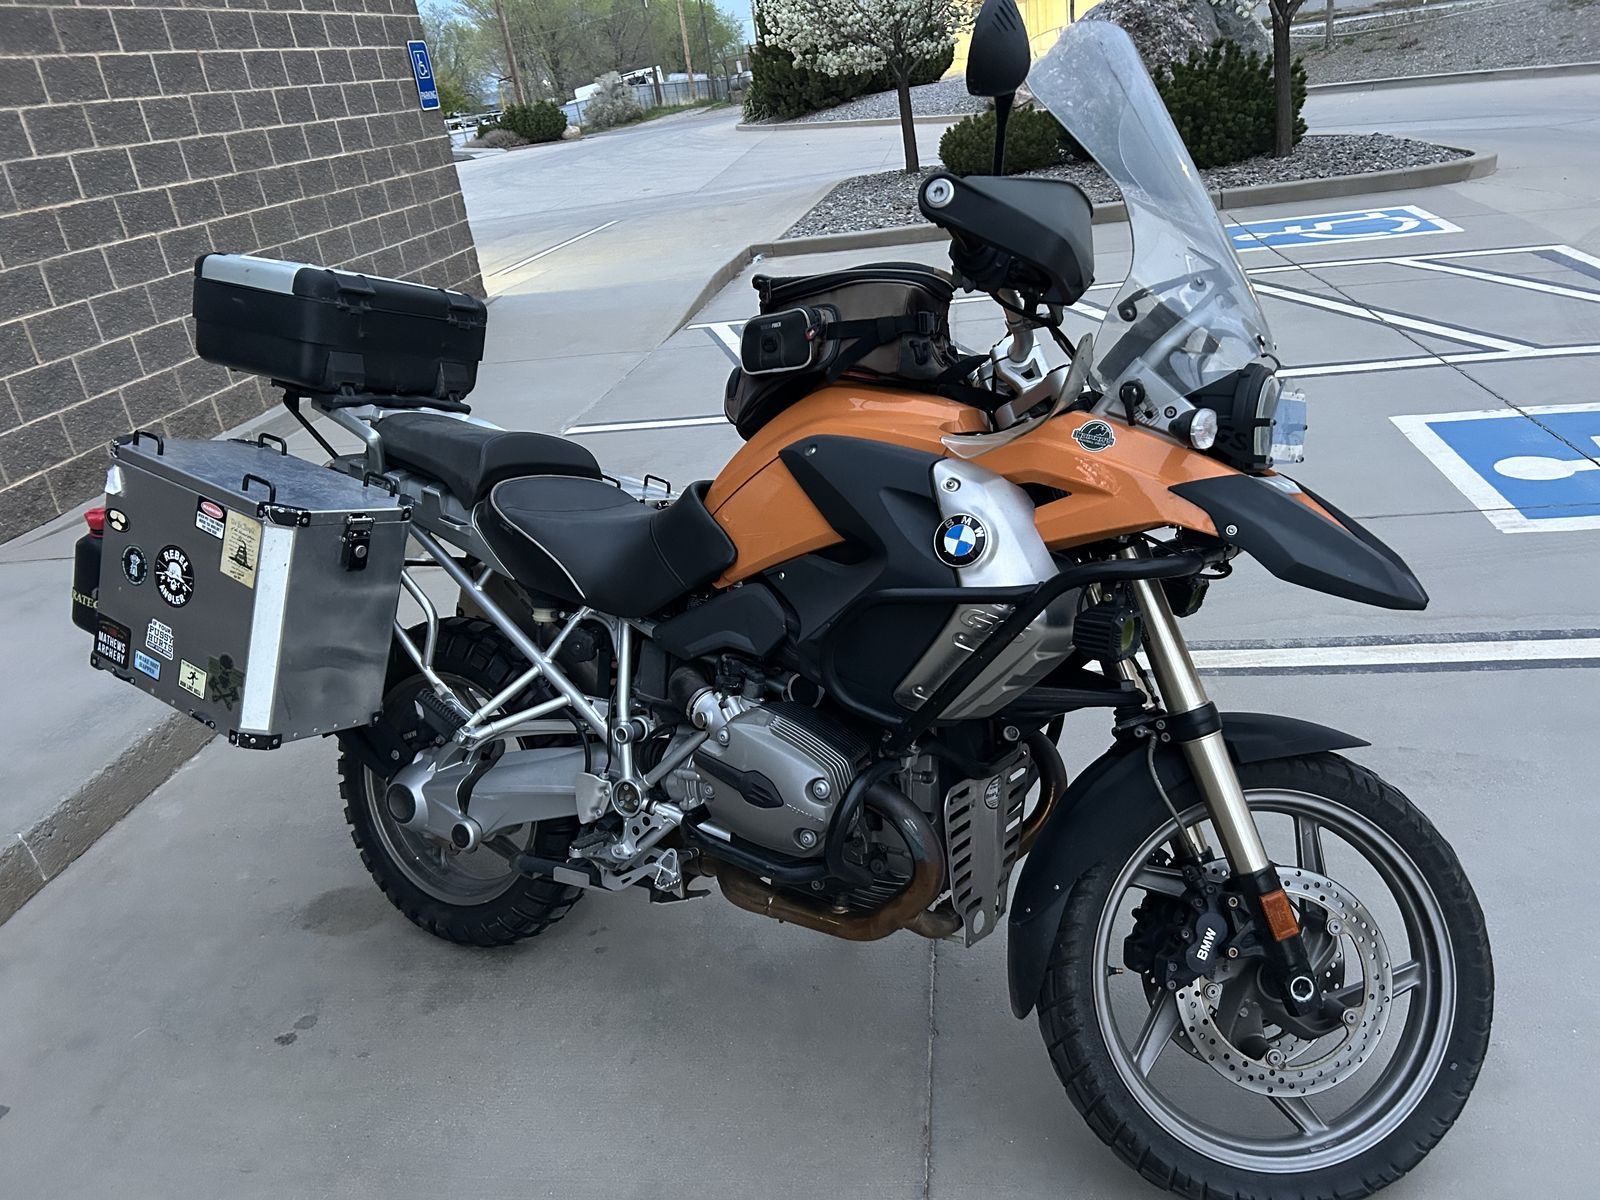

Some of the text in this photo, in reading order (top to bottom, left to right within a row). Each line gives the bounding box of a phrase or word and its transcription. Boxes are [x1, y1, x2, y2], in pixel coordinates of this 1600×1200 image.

[944, 515, 985, 538] BMW
[163, 549, 189, 572] REBEL
[159, 584, 186, 605] ANGLER
[98, 630, 126, 654] MATHEWS
[148, 633, 173, 652] HURTS
[149, 625, 174, 644] PUSSY
[97, 642, 125, 665] ARCHERY
[1196, 927, 1217, 961] BMW
